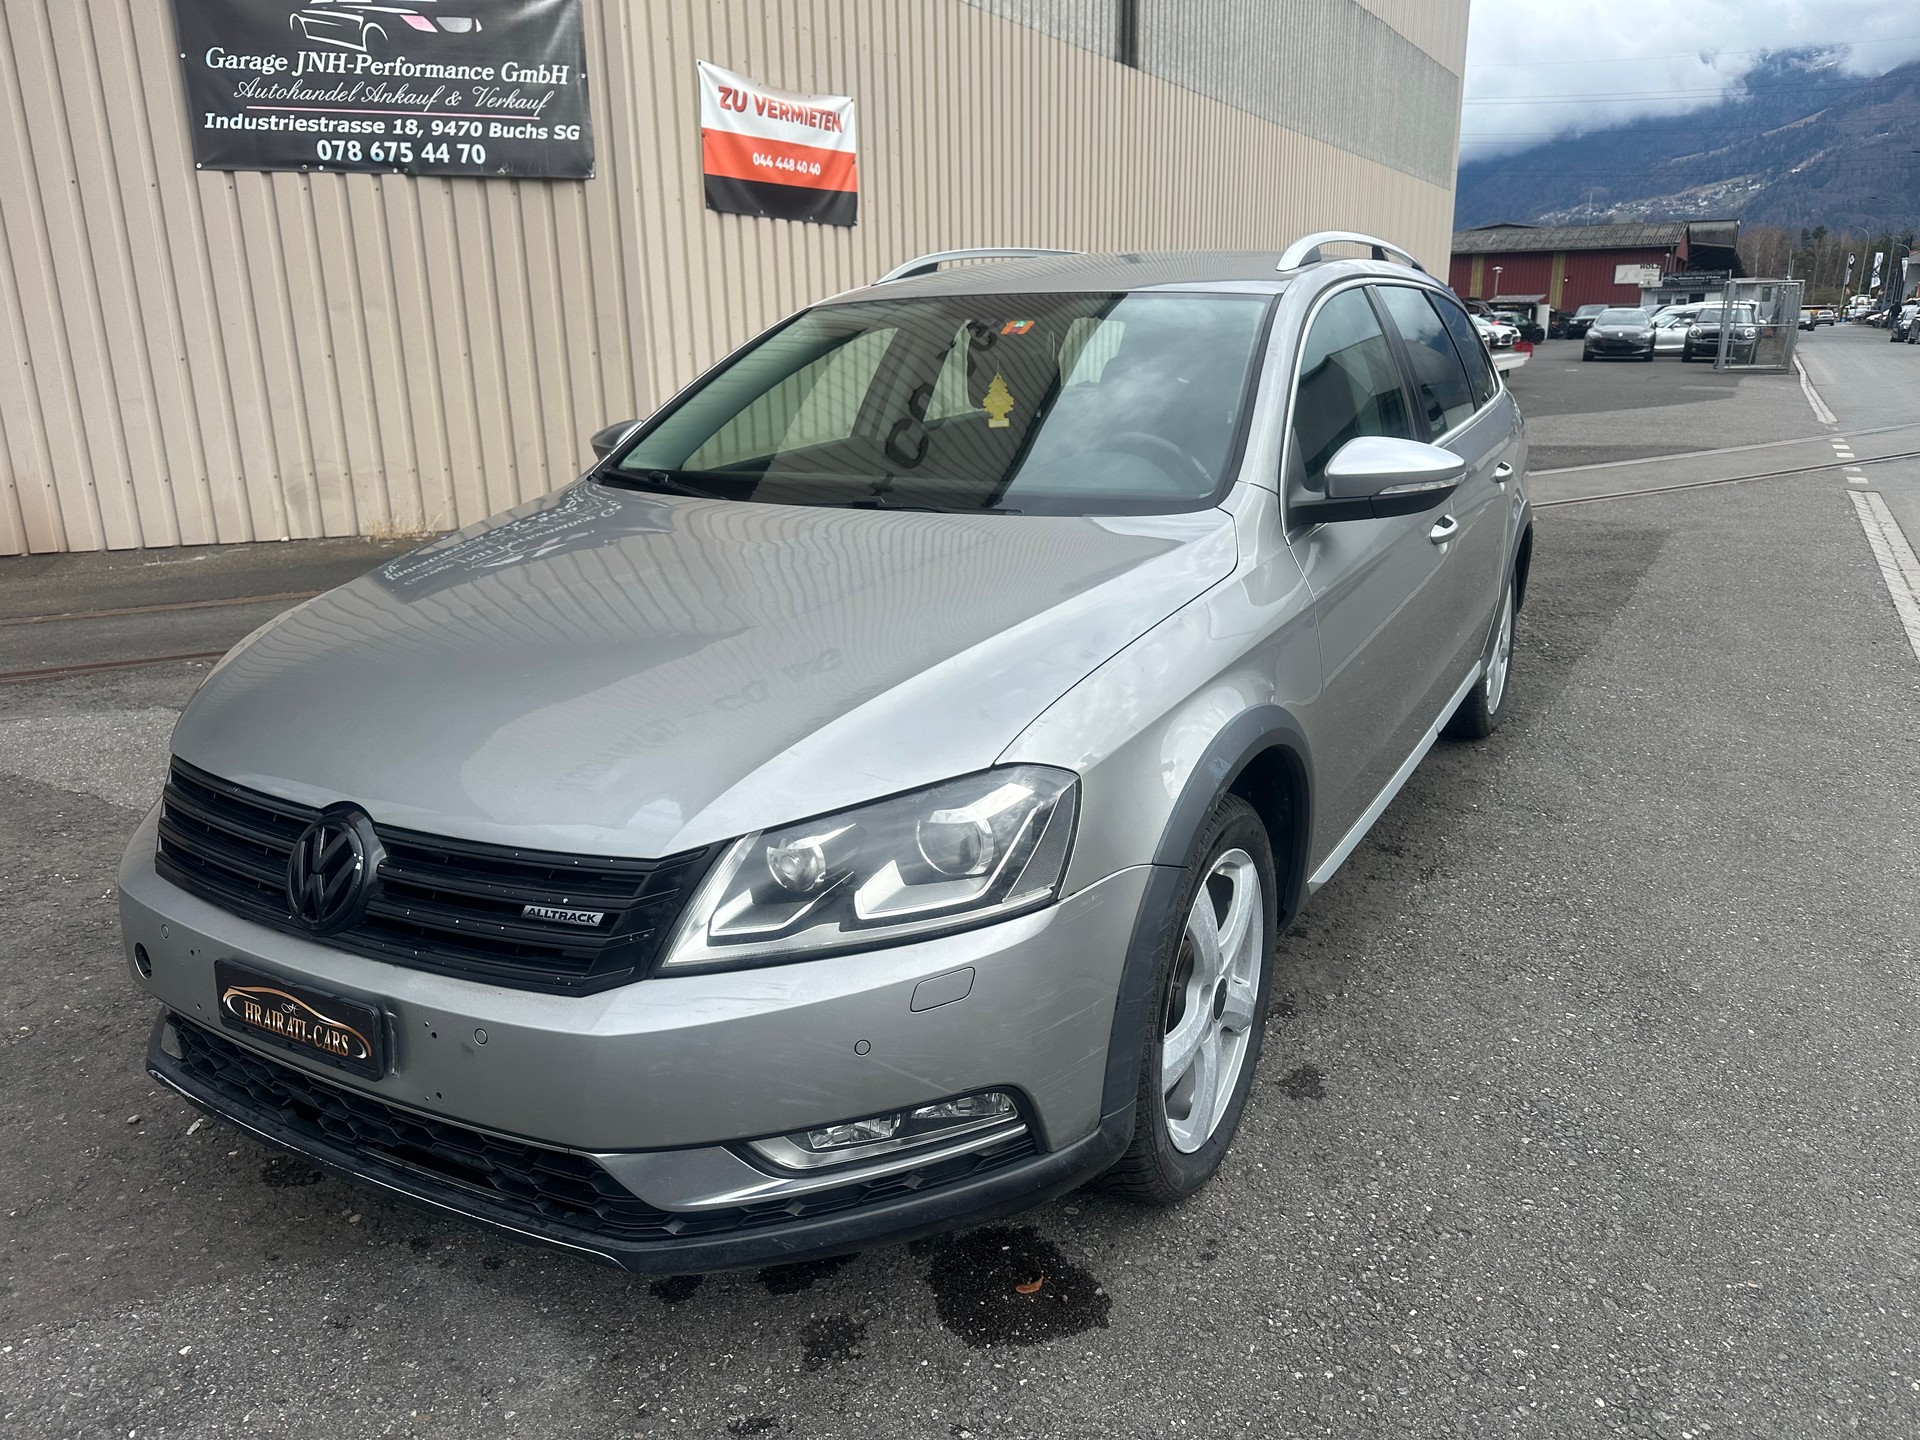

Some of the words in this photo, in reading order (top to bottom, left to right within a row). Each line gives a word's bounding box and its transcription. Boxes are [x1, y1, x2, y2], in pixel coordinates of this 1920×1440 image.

[205, 47, 288, 73] Garage
[292, 51, 495, 82] JNH-Performance
[500, 62, 570, 85] GmbH
[233, 76, 359, 104] Autohandel
[361, 86, 440, 114] Ankauf
[444, 91, 462, 107] &
[471, 86, 555, 115] Verkauf
[718, 86, 748, 113] ZU
[753, 93, 843, 133] VERMIETEN
[204, 112, 386, 135] Industriestrasse
[393, 119, 424, 139] 18,
[431, 121, 483, 138] 9470
[489, 123, 549, 141] Buchs
[553, 124, 581, 142] SG
[317, 140, 363, 162] 078
[369, 141, 414, 164] 675
[421, 143, 450, 164] 44
[457, 143, 487, 165] 70
[753, 152, 774, 168] 044
[775, 156, 796, 172] 448
[796, 160, 808, 174] 40
[809, 162, 822, 176] 40
[526, 907, 597, 924] ALLTRACK
